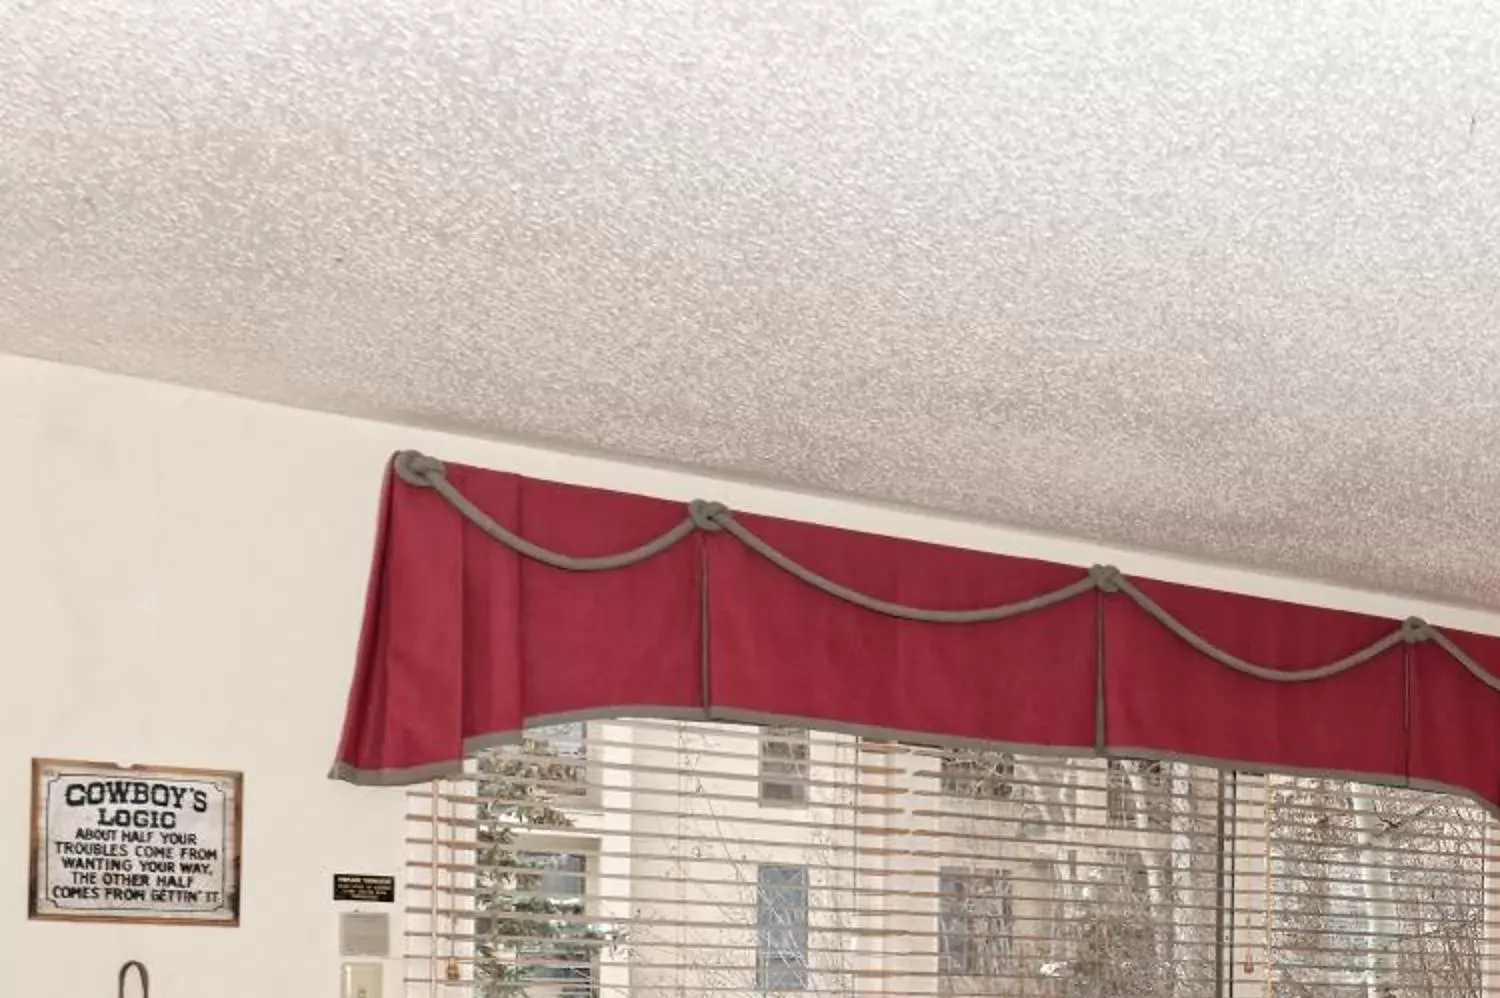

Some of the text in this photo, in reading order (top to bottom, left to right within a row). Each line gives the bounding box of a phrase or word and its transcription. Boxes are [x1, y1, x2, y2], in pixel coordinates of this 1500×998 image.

[65, 781, 207, 813] COWBOY'S
[98, 808, 176, 829] LOGIC
[75, 828, 197, 845] ABOUT HALF YOUR
[55, 841, 217, 861] TROUBLES COME FROM
[61, 857, 132, 872] WANTING
[139, 860, 175, 873] YOUR
[71, 871, 194, 888] THE OTHER HALF
[52, 885, 100, 899] COMES
[105, 887, 145, 901] FROM
